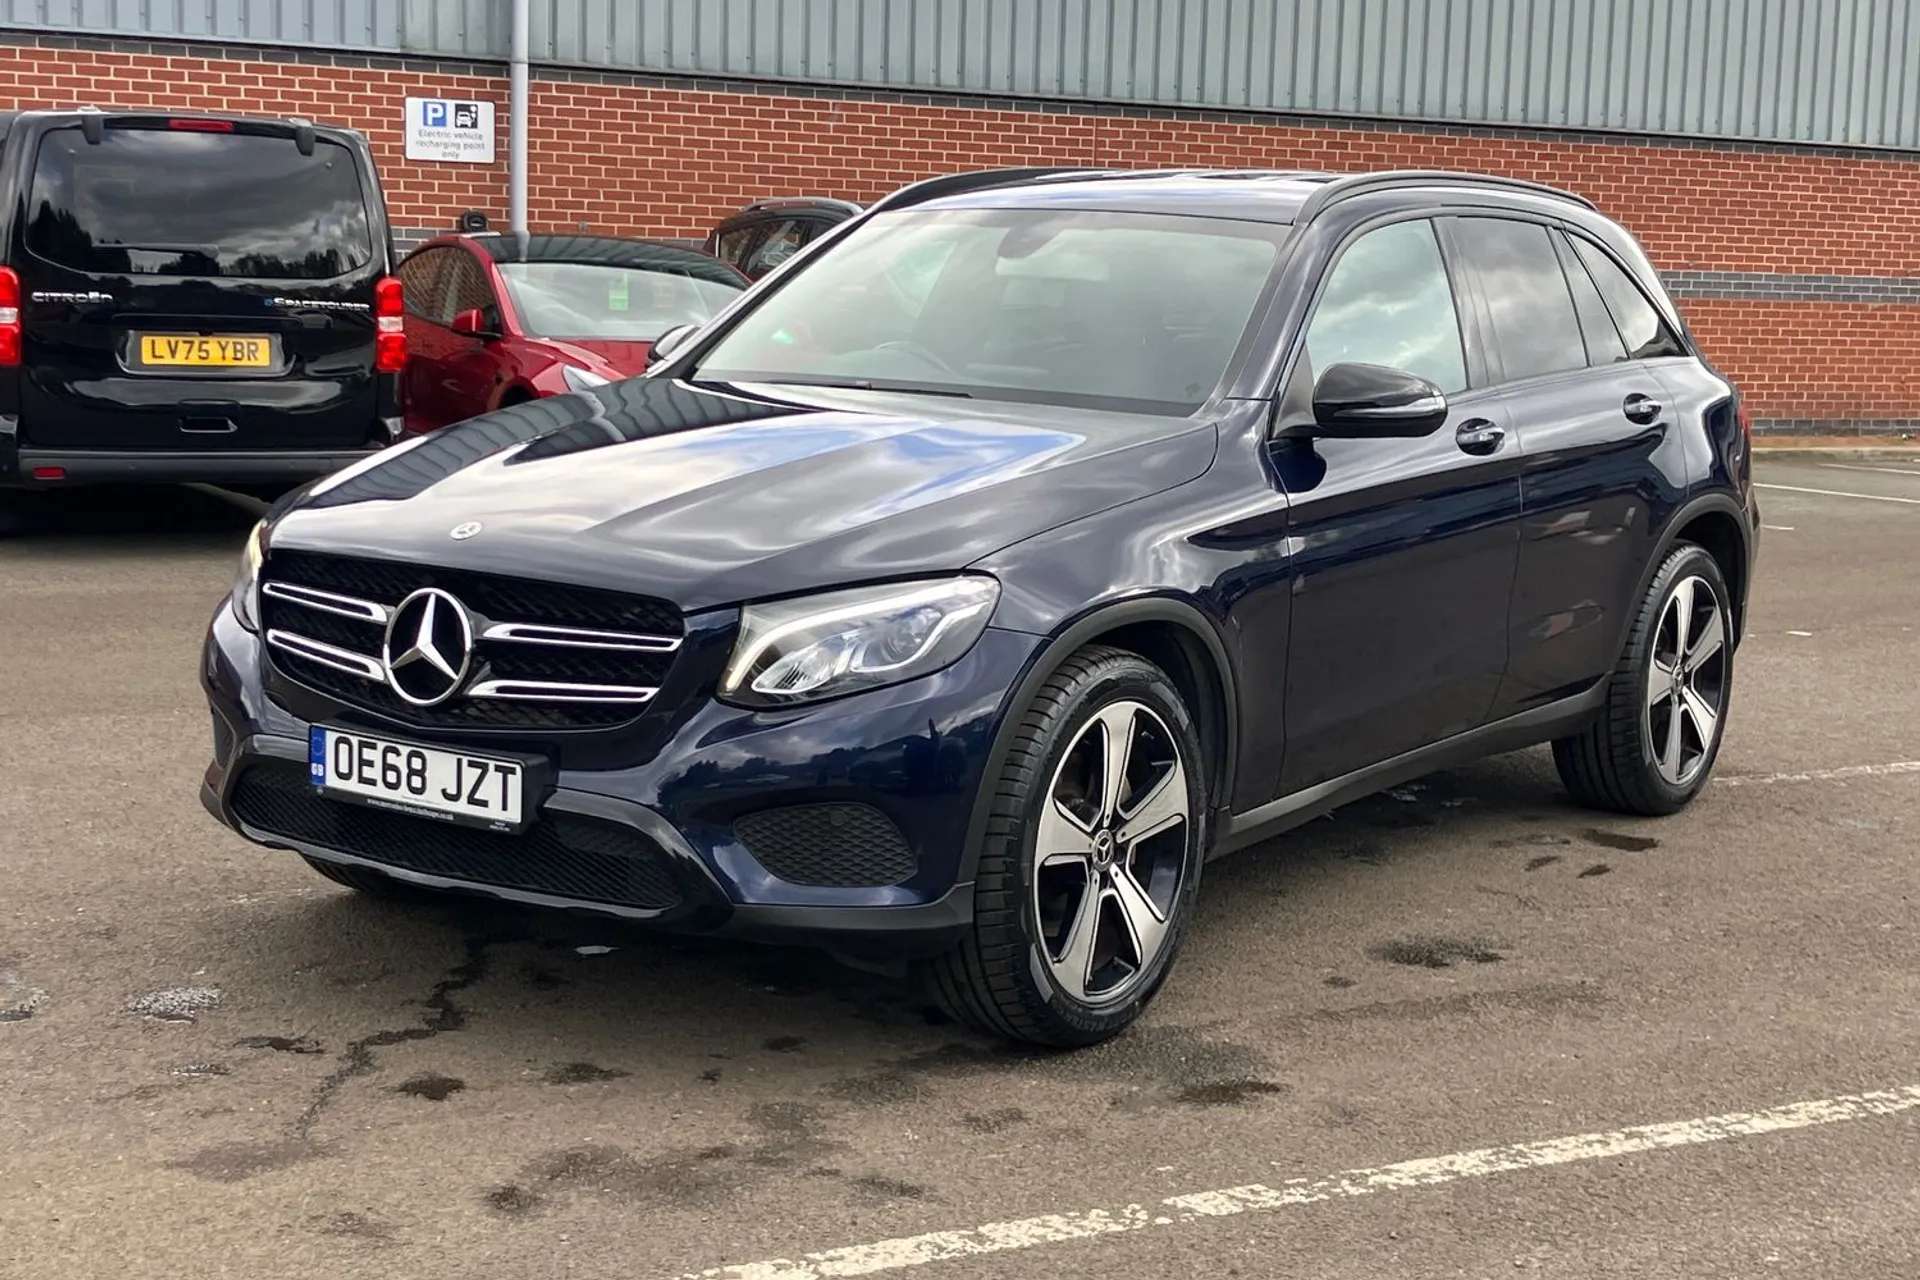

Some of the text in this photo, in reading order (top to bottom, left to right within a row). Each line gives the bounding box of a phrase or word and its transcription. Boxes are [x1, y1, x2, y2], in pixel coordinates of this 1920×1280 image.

[426, 102, 444, 126] P
[418, 129, 483, 140] Electric vehicle
[416, 140, 485, 151] recharging point
[441, 151, 460, 159] only
[150, 338, 260, 362] LV75 YBR
[333, 735, 428, 796] OE68
[440, 757, 517, 812] JZT
